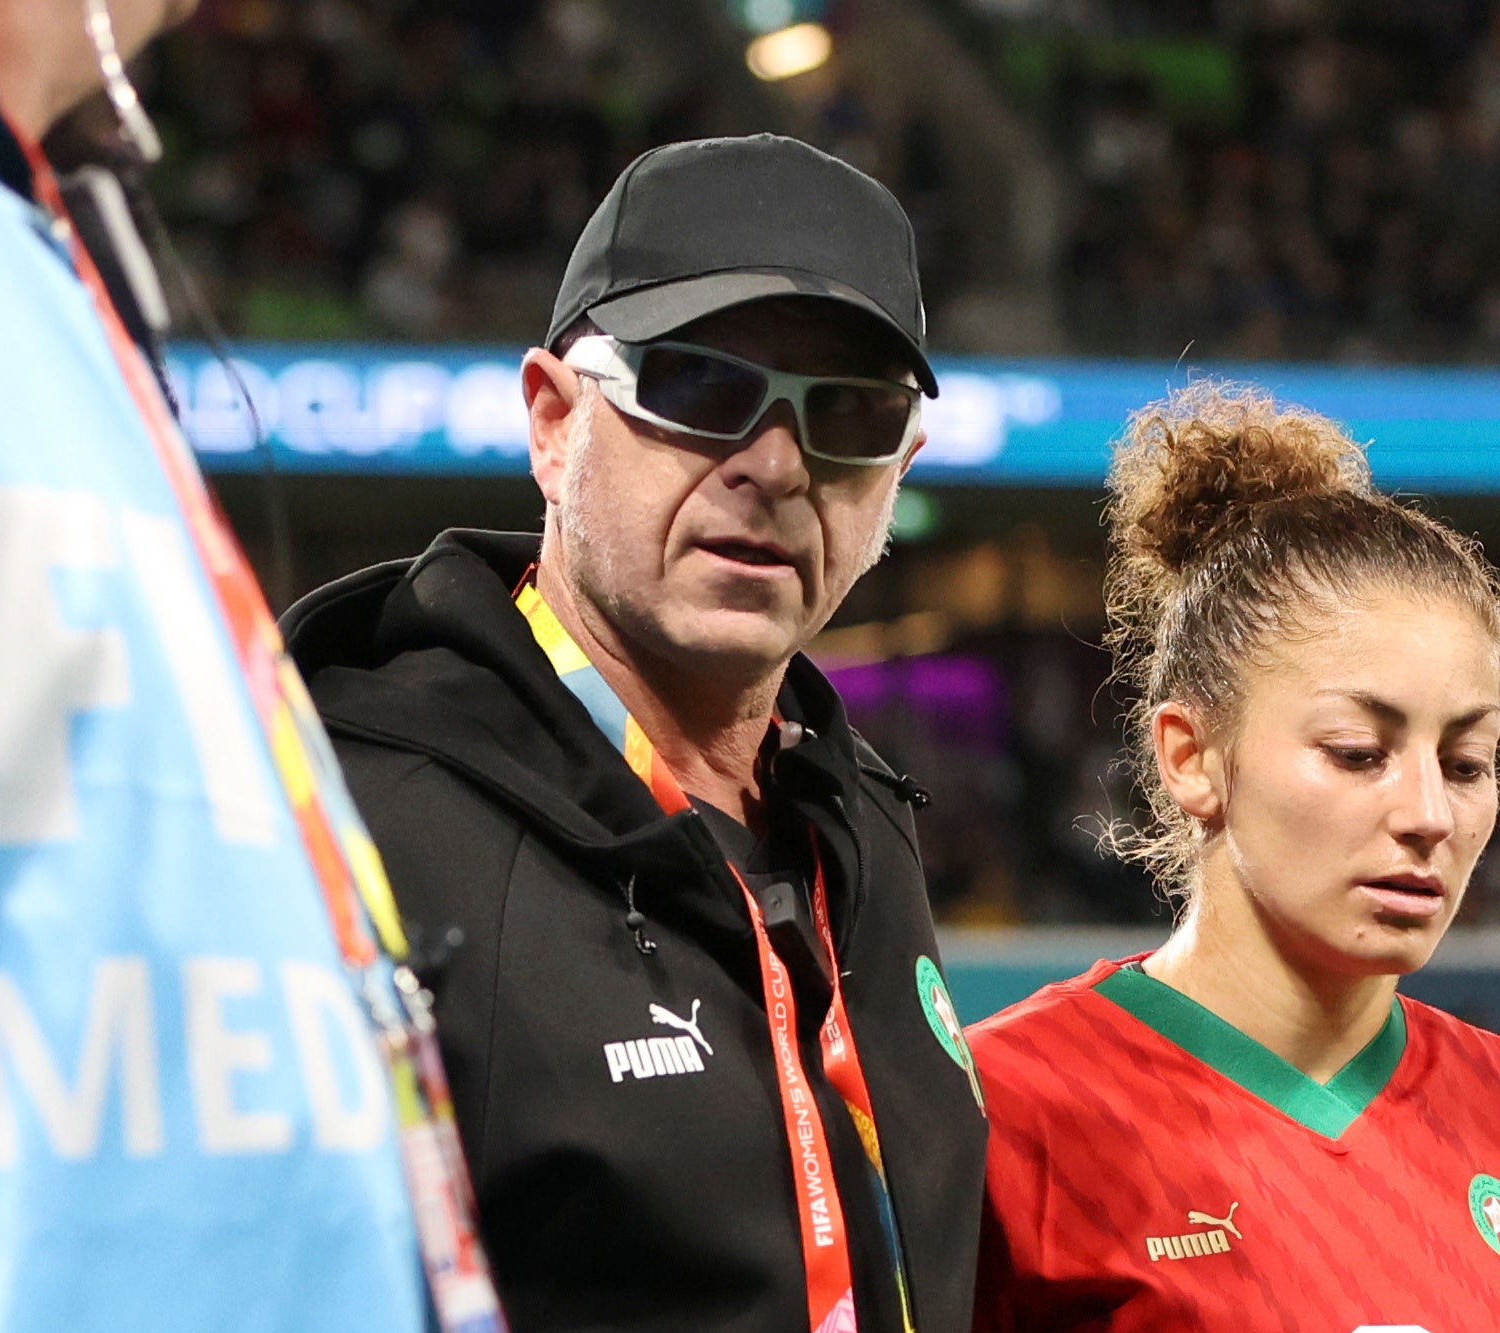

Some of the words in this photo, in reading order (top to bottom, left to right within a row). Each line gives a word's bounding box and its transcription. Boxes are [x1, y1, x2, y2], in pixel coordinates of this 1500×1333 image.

[768, 952, 785, 999] CUP
[603, 1035, 705, 1083] PUMA
[774, 1003, 796, 1084] WORLD
[789, 1088, 825, 1197] WOMEN'S
[811, 1196, 834, 1247] FIFA
[1146, 1229, 1231, 1262] PUMA
